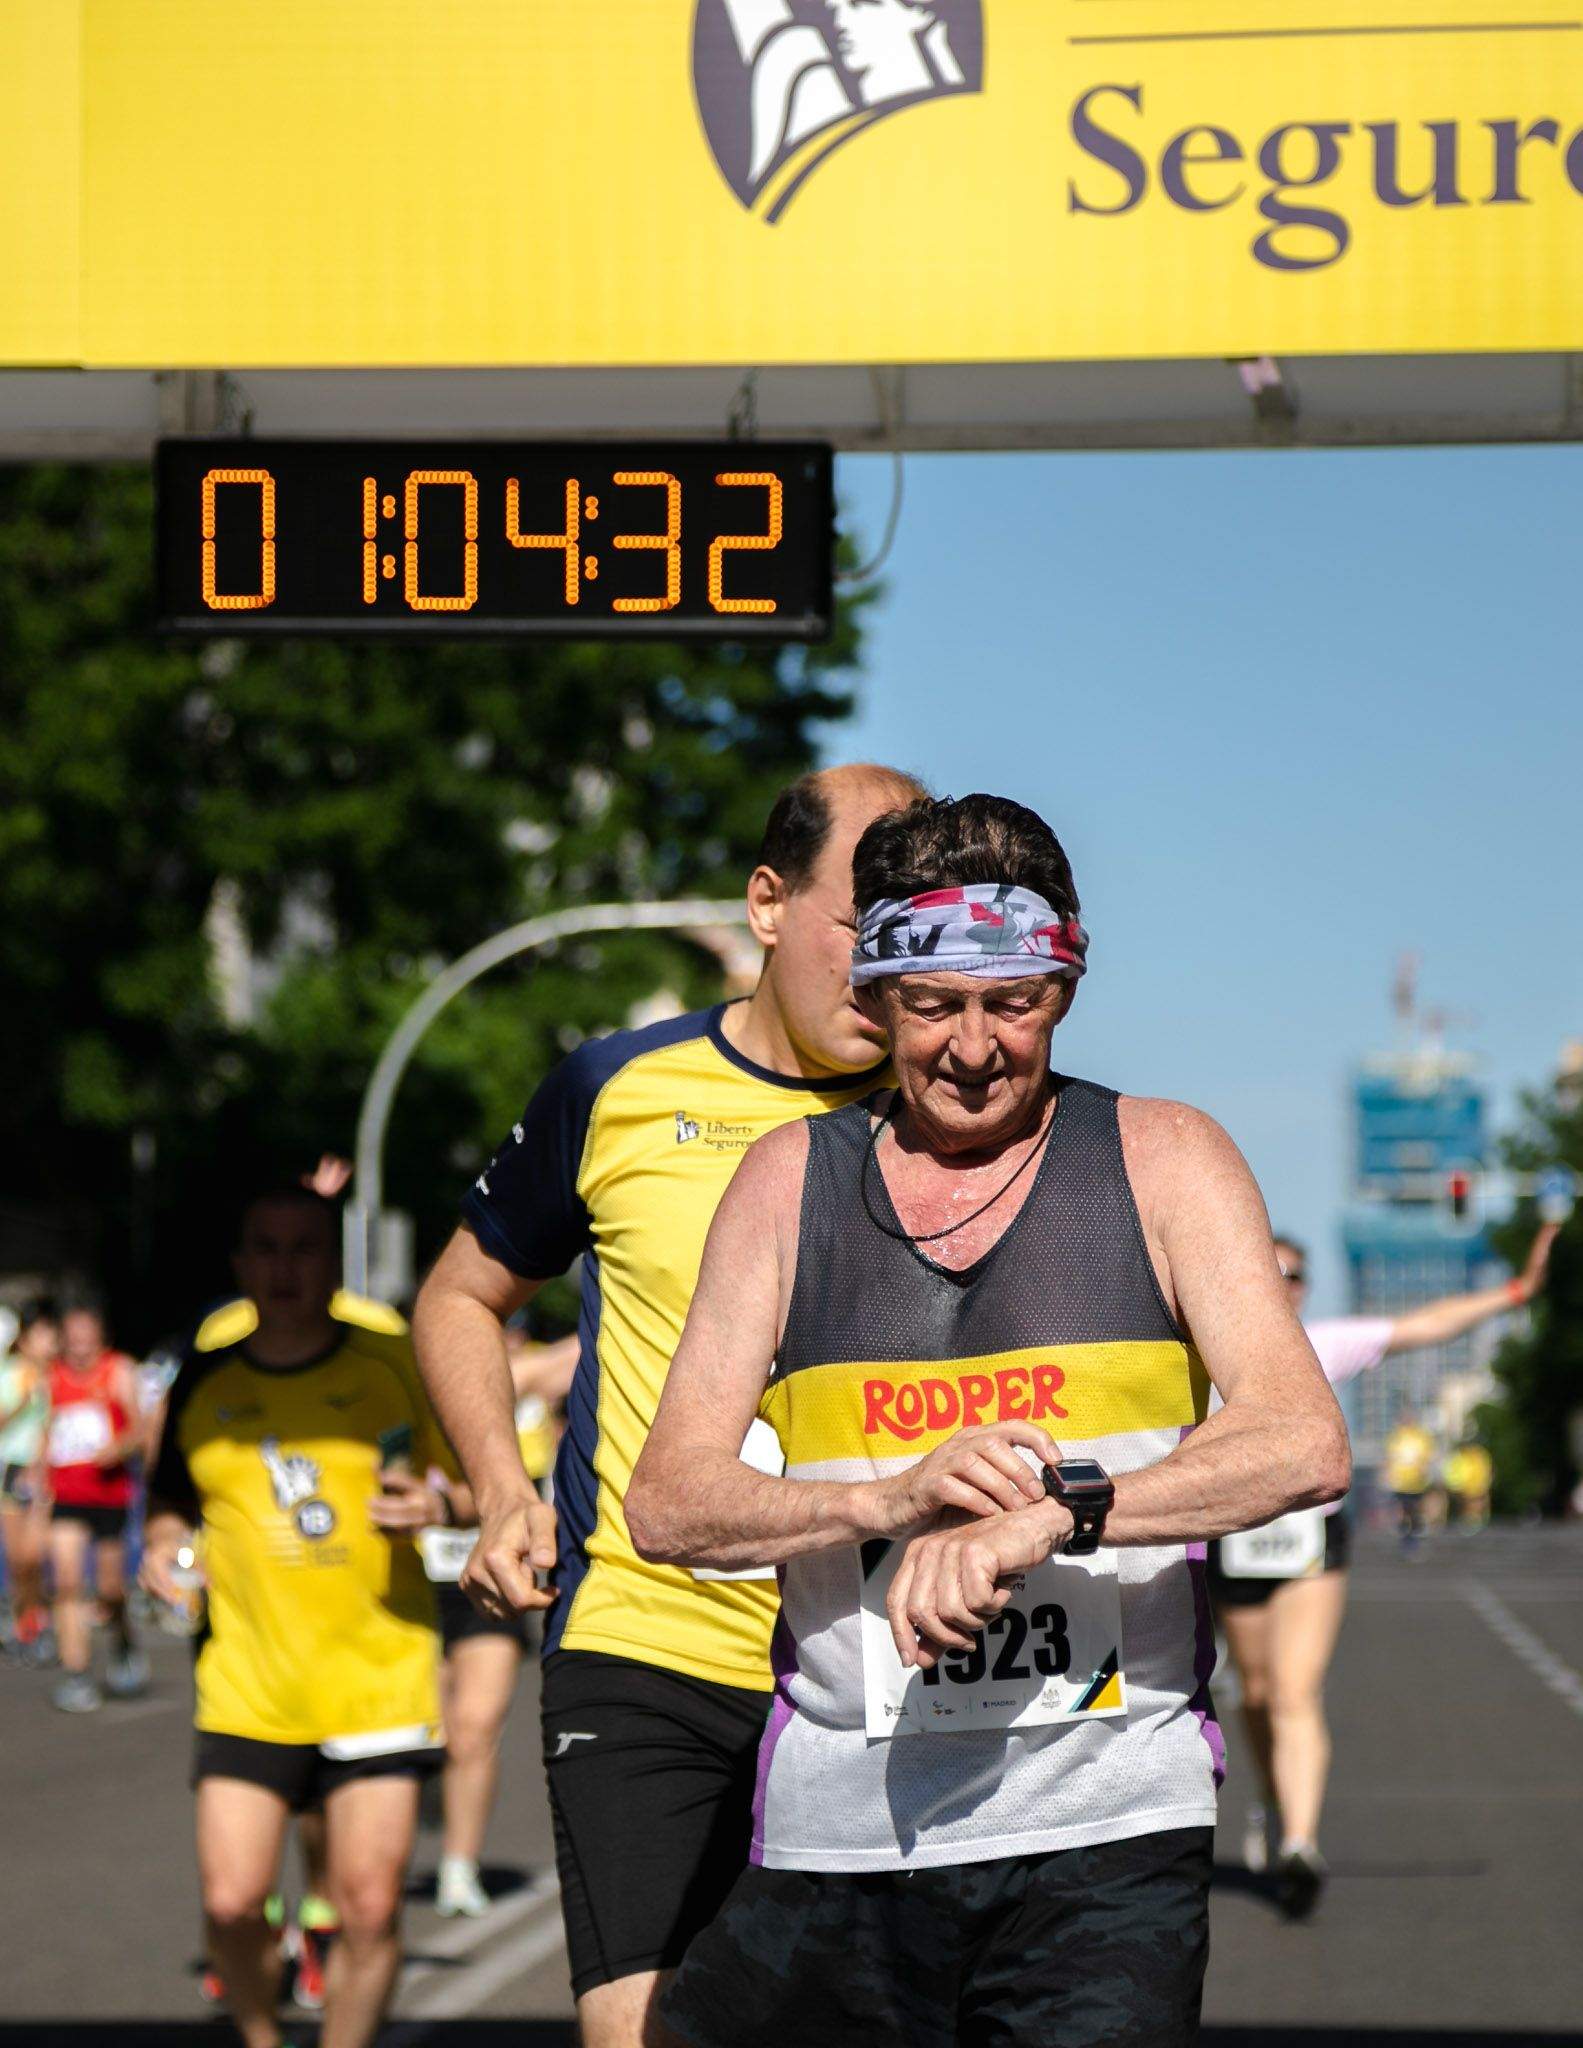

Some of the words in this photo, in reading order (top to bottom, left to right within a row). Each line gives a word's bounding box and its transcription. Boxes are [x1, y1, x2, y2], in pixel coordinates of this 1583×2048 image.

[1067, 82, 1583, 273] Segur
[707, 1121, 754, 1136] Liberty
[864, 1364, 1069, 1441] RODPER
